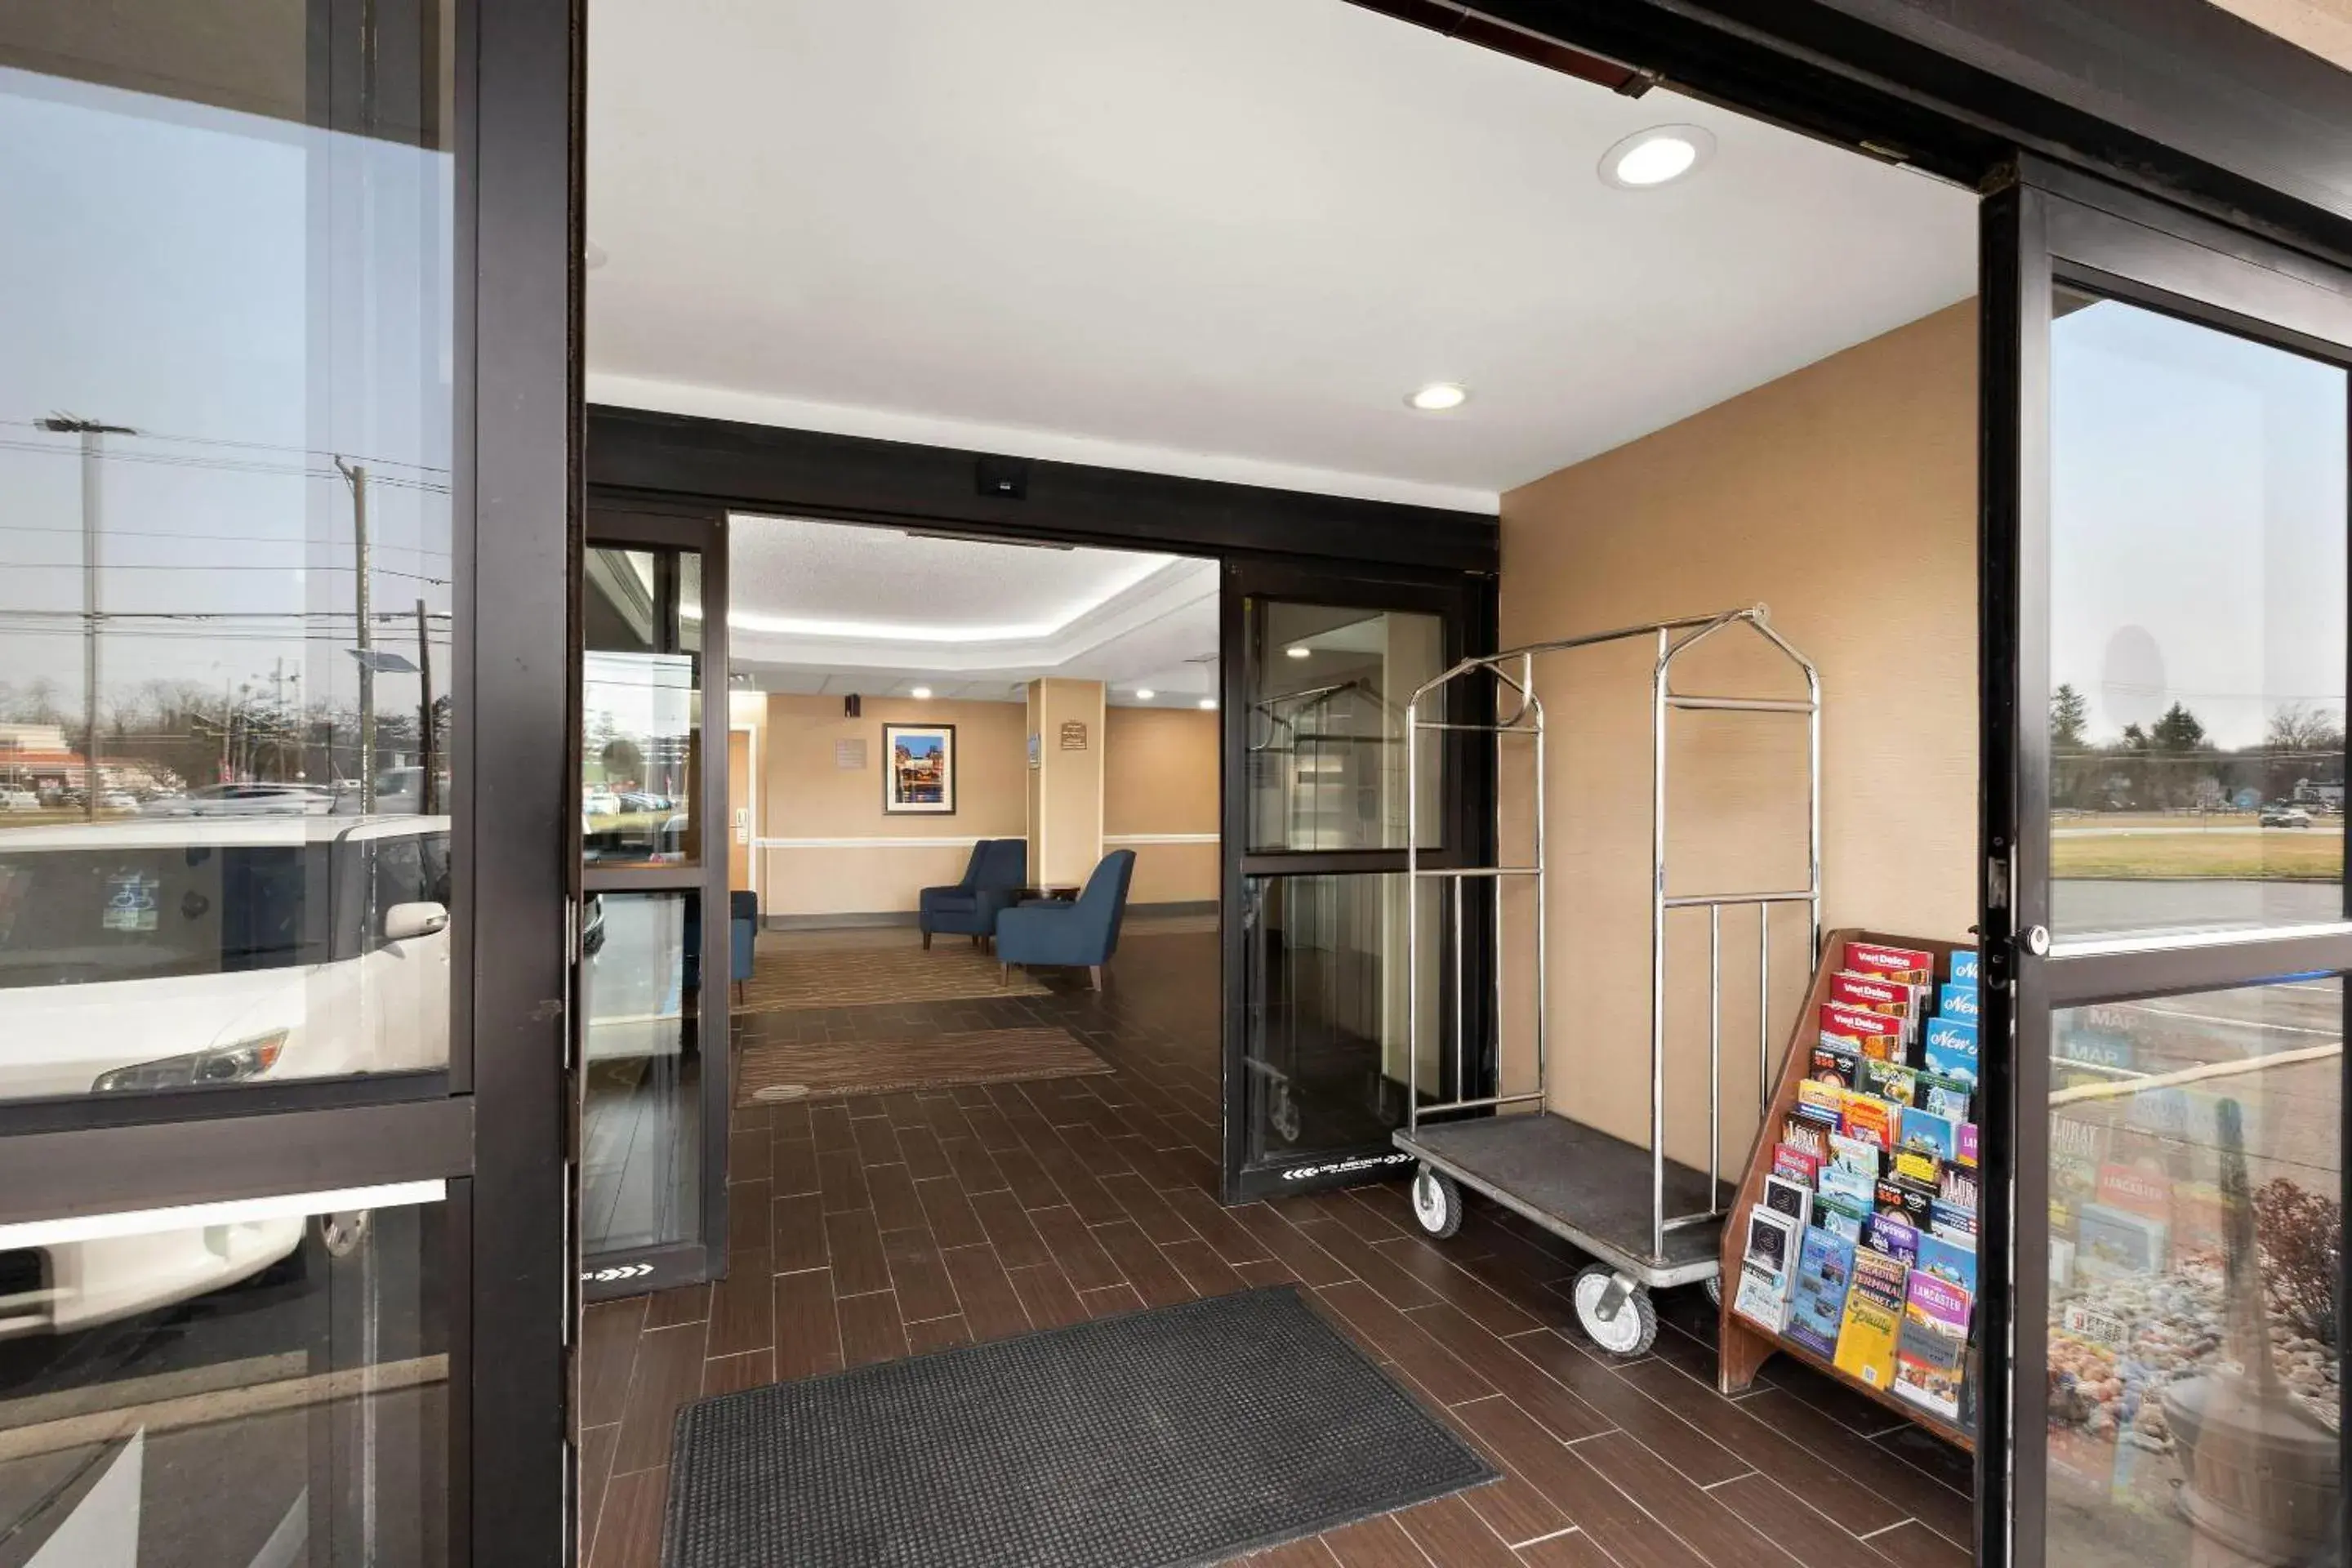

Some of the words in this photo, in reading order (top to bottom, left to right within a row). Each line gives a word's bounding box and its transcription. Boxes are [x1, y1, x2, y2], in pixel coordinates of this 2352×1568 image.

[1930, 1029, 1970, 1051] New
[2068, 1042, 2119, 1063] MAP
[1913, 1283, 1961, 1312] LANCASTER
